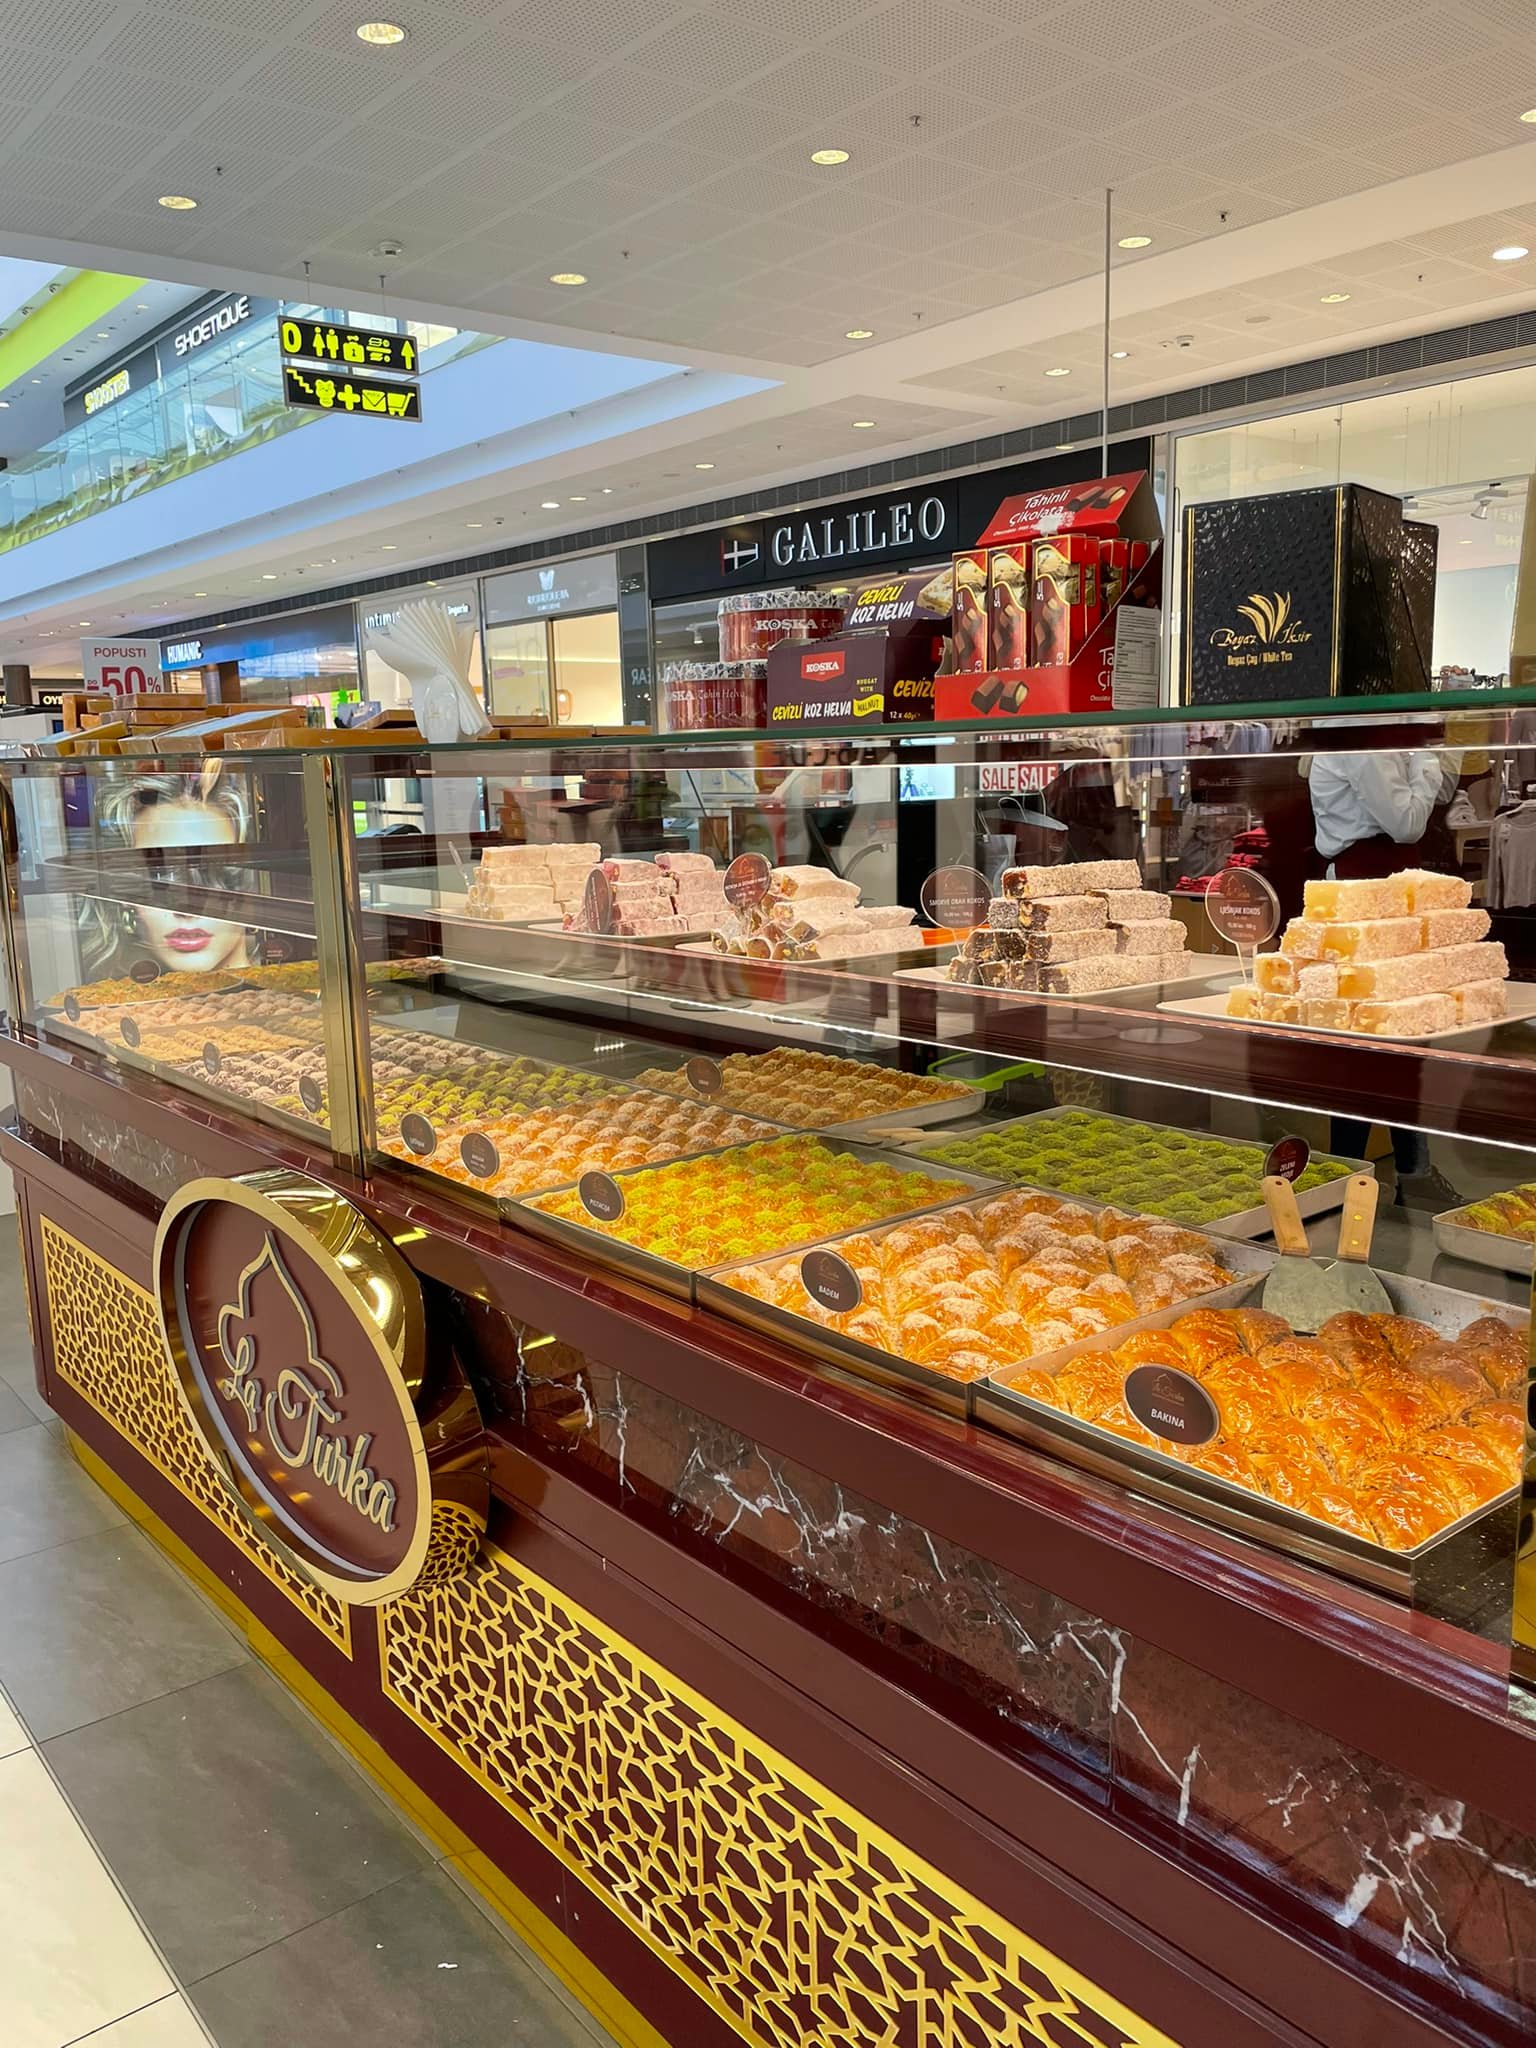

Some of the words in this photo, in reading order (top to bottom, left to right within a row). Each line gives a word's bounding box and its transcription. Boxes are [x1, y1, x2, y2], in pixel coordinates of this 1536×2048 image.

[174, 295, 250, 357] SHOETIQUE
[1024, 489, 1071, 510] Tahinli
[771, 496, 946, 567] GALILEO
[850, 604, 875, 625] KOZ
[876, 600, 915, 621] HELVA
[755, 618, 819, 631] KOSKA
[94, 647, 147, 658] POPUSTI
[167, 640, 202, 664] HUMANIC
[1280, 650, 1293, 661] Tea
[805, 660, 840, 674] KOSKA
[671, 689, 696, 701] SKA
[803, 701, 823, 719] KOZ
[823, 700, 852, 718] HELVA
[889, 710, 897, 719] 12
[981, 765, 1016, 790] SALE
[1019, 764, 1057, 791] SALE
[818, 1285, 840, 1300] BADEM
[1150, 1408, 1185, 1430] BAKINA
[265, 1365, 397, 1533] Turka
